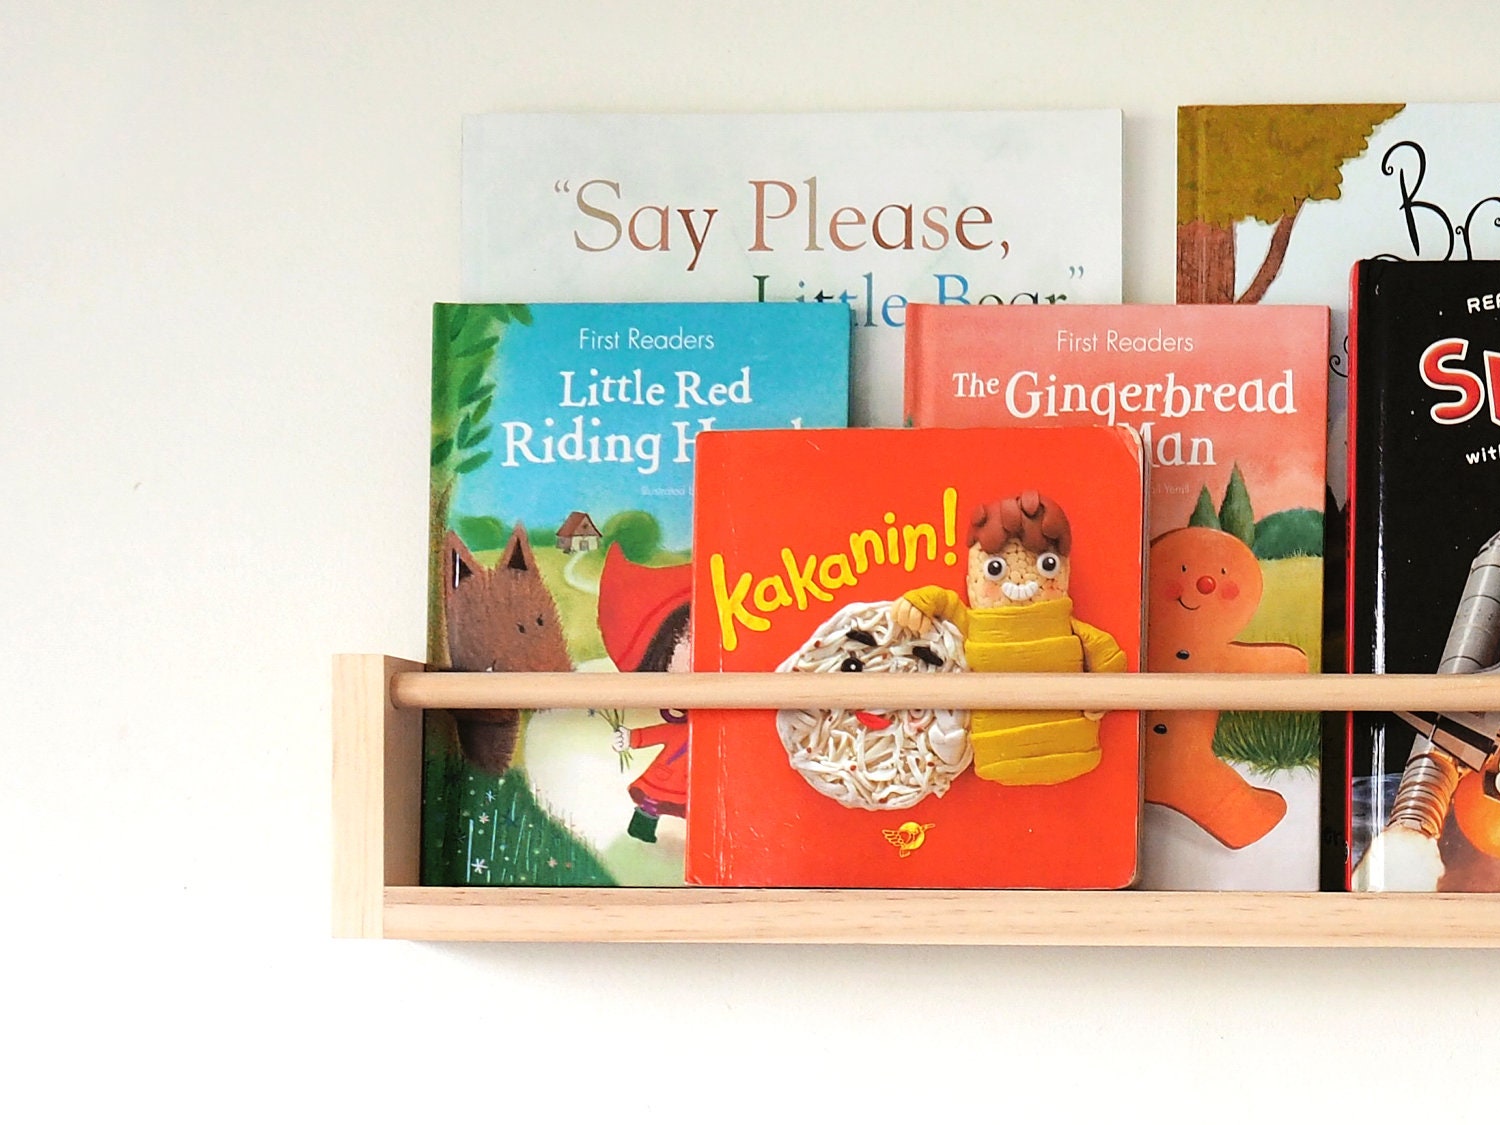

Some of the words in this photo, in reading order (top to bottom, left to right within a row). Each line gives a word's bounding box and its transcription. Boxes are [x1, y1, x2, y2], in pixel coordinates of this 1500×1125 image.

[747, 175, 1010, 259] Please,
[579, 327, 620, 350] First
[628, 326, 716, 350] Readers
[1056, 329, 1098, 352] First
[1106, 328, 1194, 352] Readers
[558, 367, 666, 408] Little
[673, 365, 753, 409] Red
[952, 372, 1000, 398] The
[1004, 368, 1298, 427] Gingerbread
[500, 414, 662, 475] Riding
[709, 486, 958, 652] kakanin!
